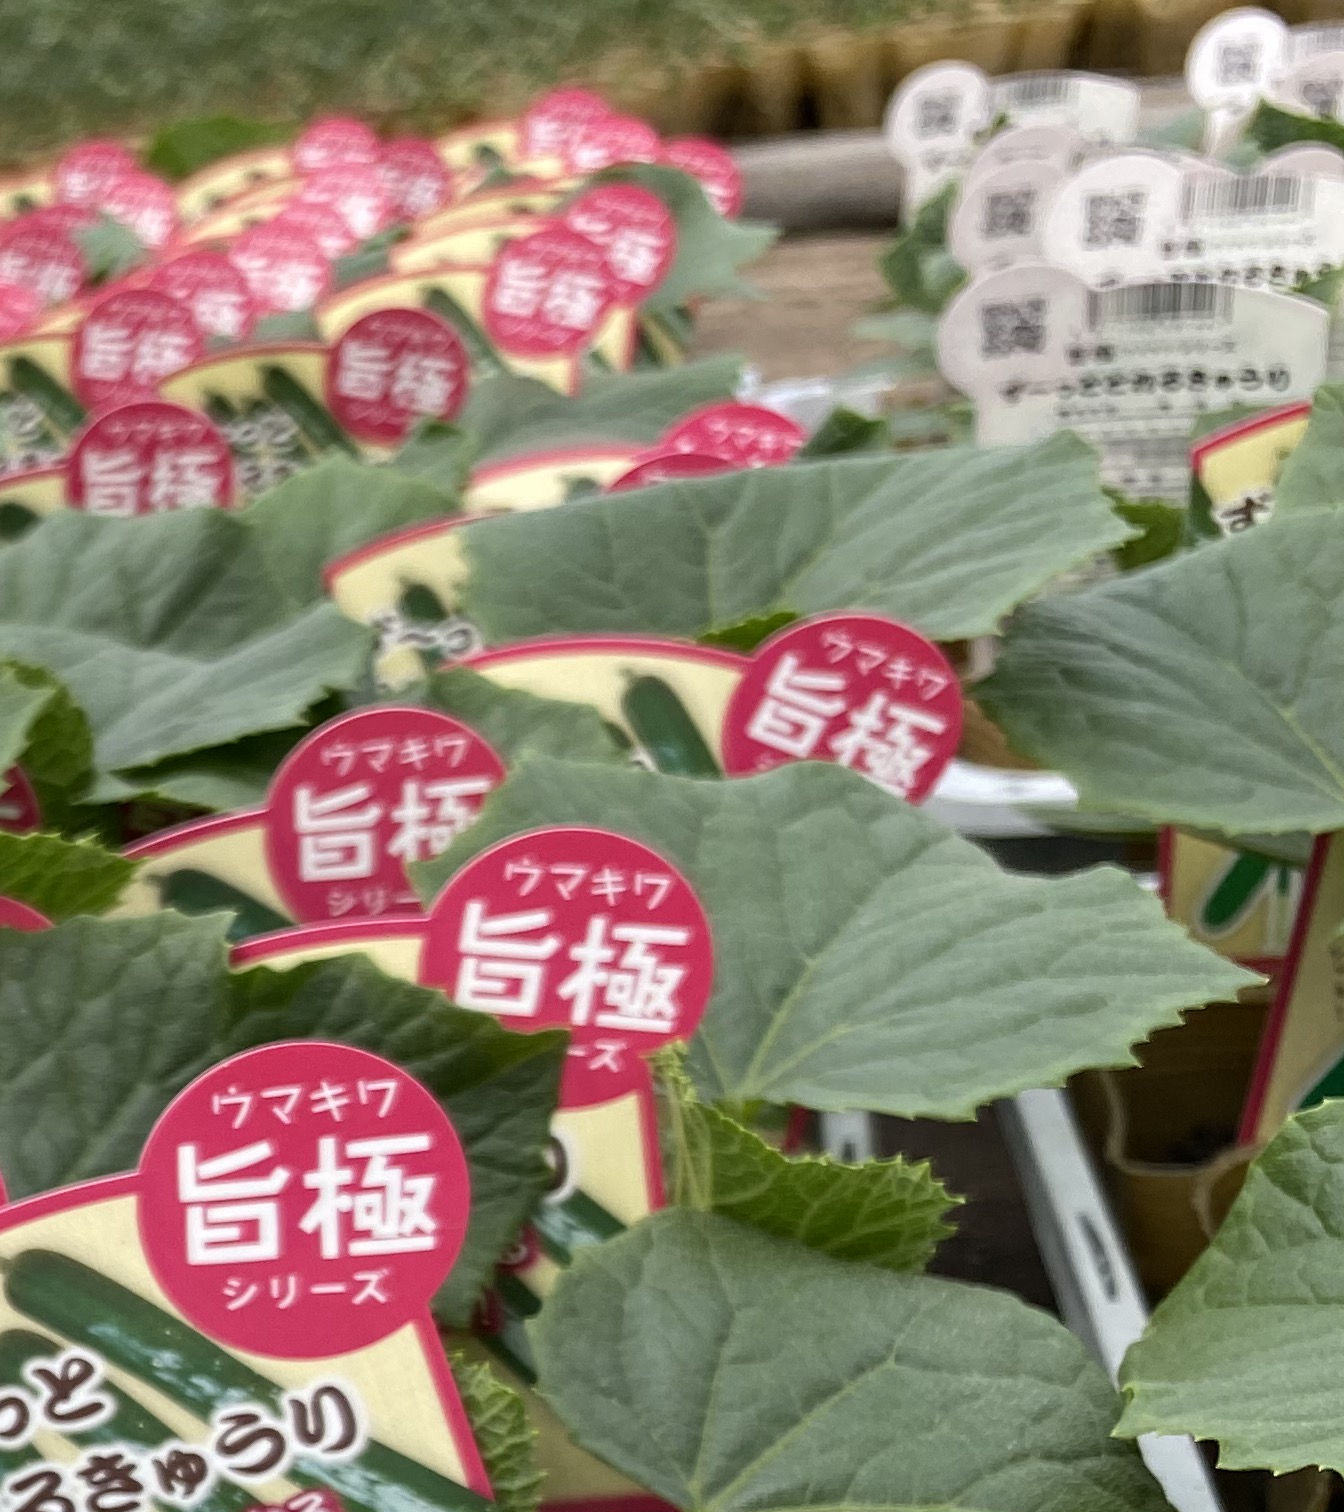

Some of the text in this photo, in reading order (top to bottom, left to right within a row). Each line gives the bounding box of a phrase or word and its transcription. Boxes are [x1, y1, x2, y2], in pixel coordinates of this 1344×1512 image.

[819, 626, 950, 700] ウマキワ
[321, 732, 469, 775] ウマキワ
[745, 652, 950, 799] 旨極
[294, 773, 496, 885] 旨極
[505, 858, 673, 909] ウマキワ
[456, 899, 692, 1035] 旨極
[210, 1077, 400, 1131] ウマキワ
[178, 1133, 439, 1265] 旨極
[220, 1270, 391, 1311] シリーズ
